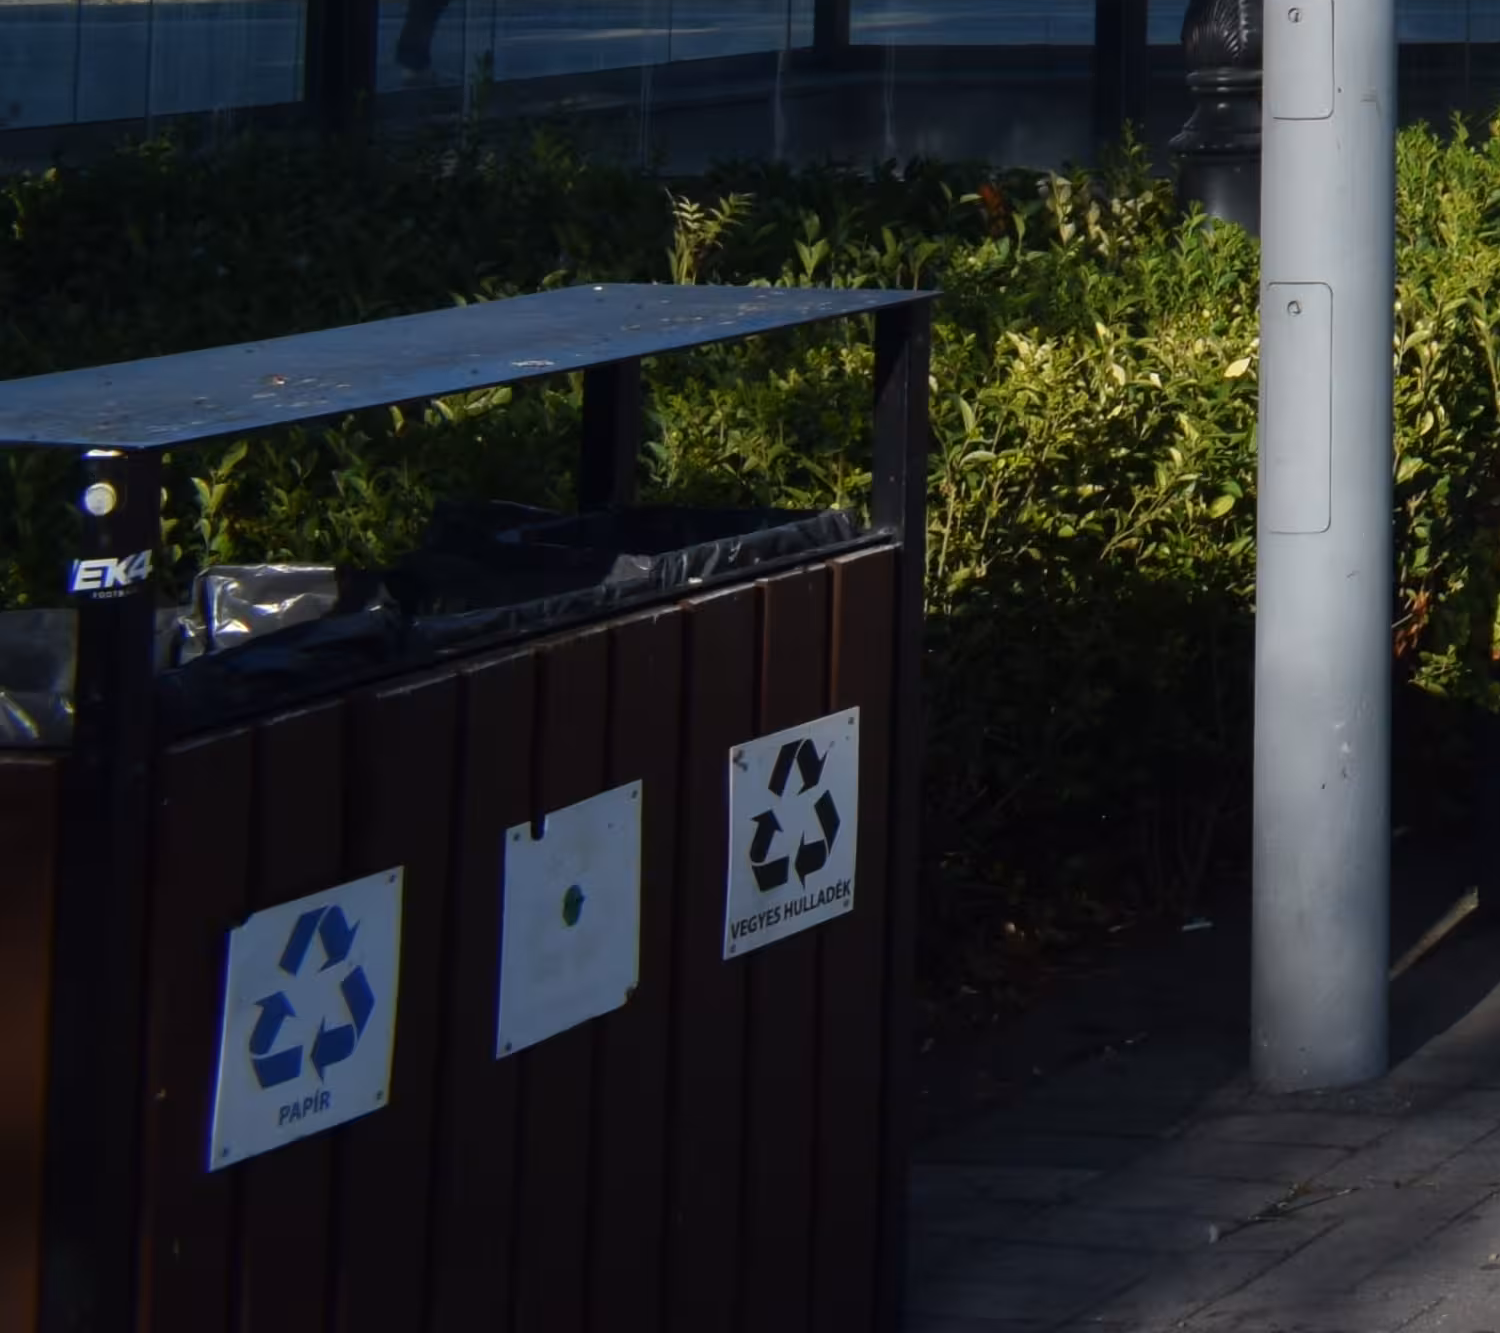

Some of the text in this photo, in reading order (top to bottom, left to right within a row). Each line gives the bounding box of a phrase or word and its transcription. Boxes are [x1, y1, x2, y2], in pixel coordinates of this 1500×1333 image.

[731, 878, 852, 940] VEGYES HULLADÉK
[278, 1088, 331, 1126] PAPÍR
